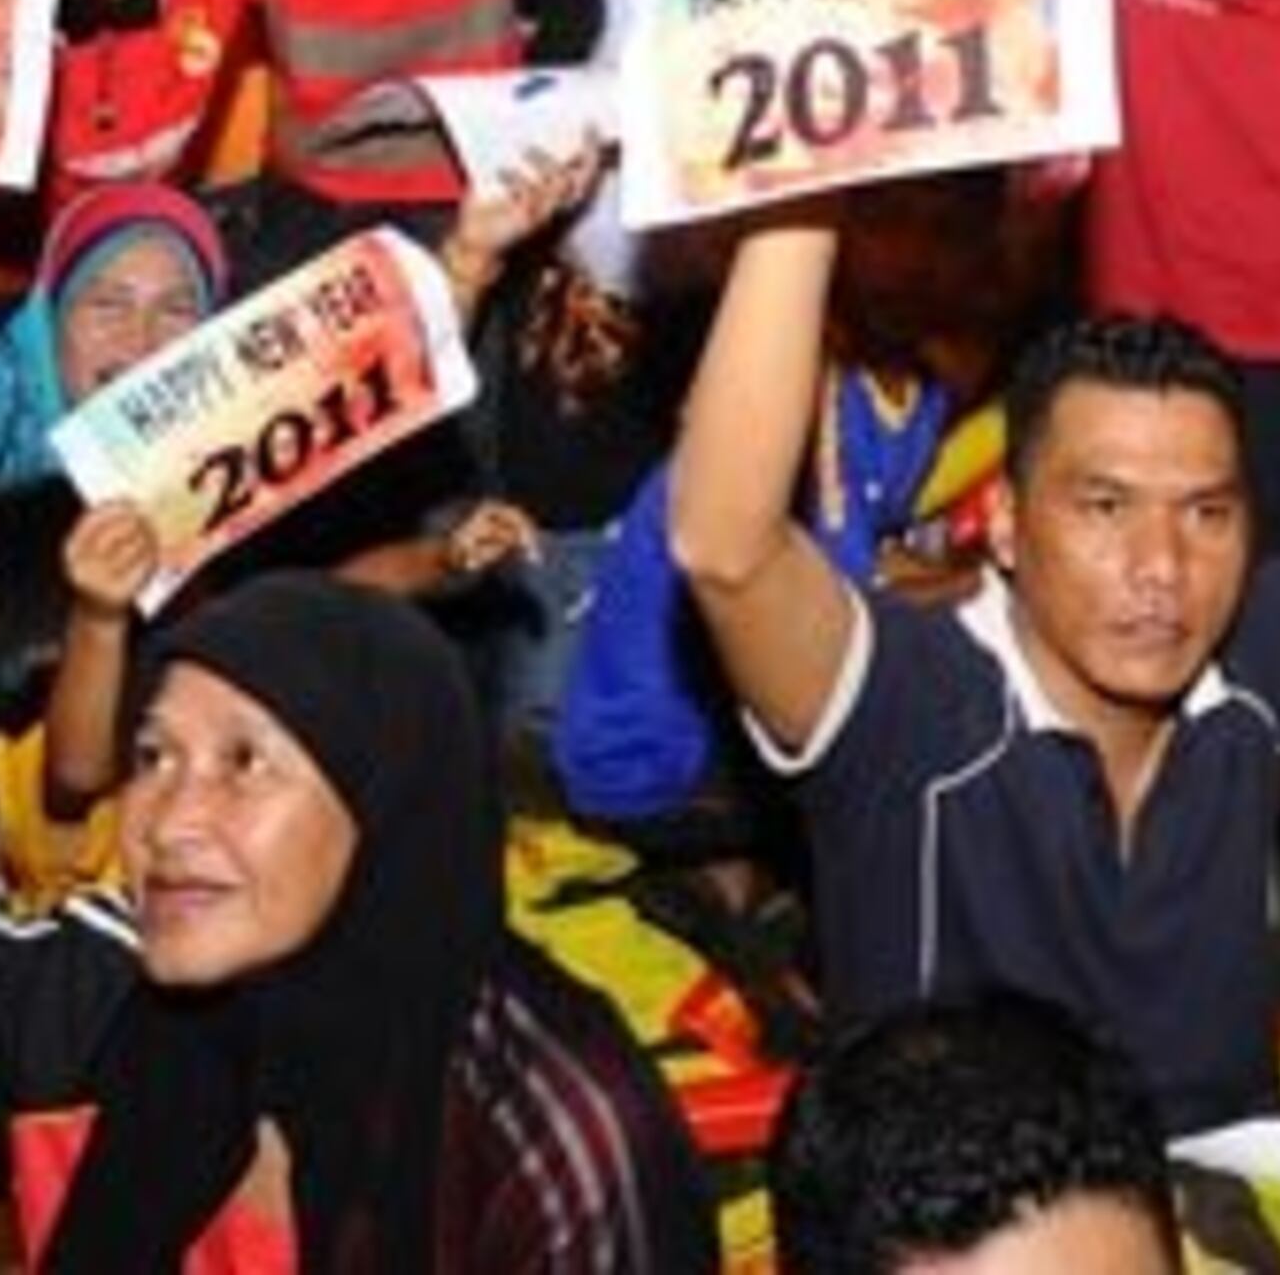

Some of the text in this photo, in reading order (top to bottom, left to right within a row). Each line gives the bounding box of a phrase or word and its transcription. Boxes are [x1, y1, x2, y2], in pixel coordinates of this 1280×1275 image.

[707, 23, 1007, 171] 2011
[118, 266, 381, 442] HAPPY NEW YEAR
[187, 354, 403, 537] 2011
